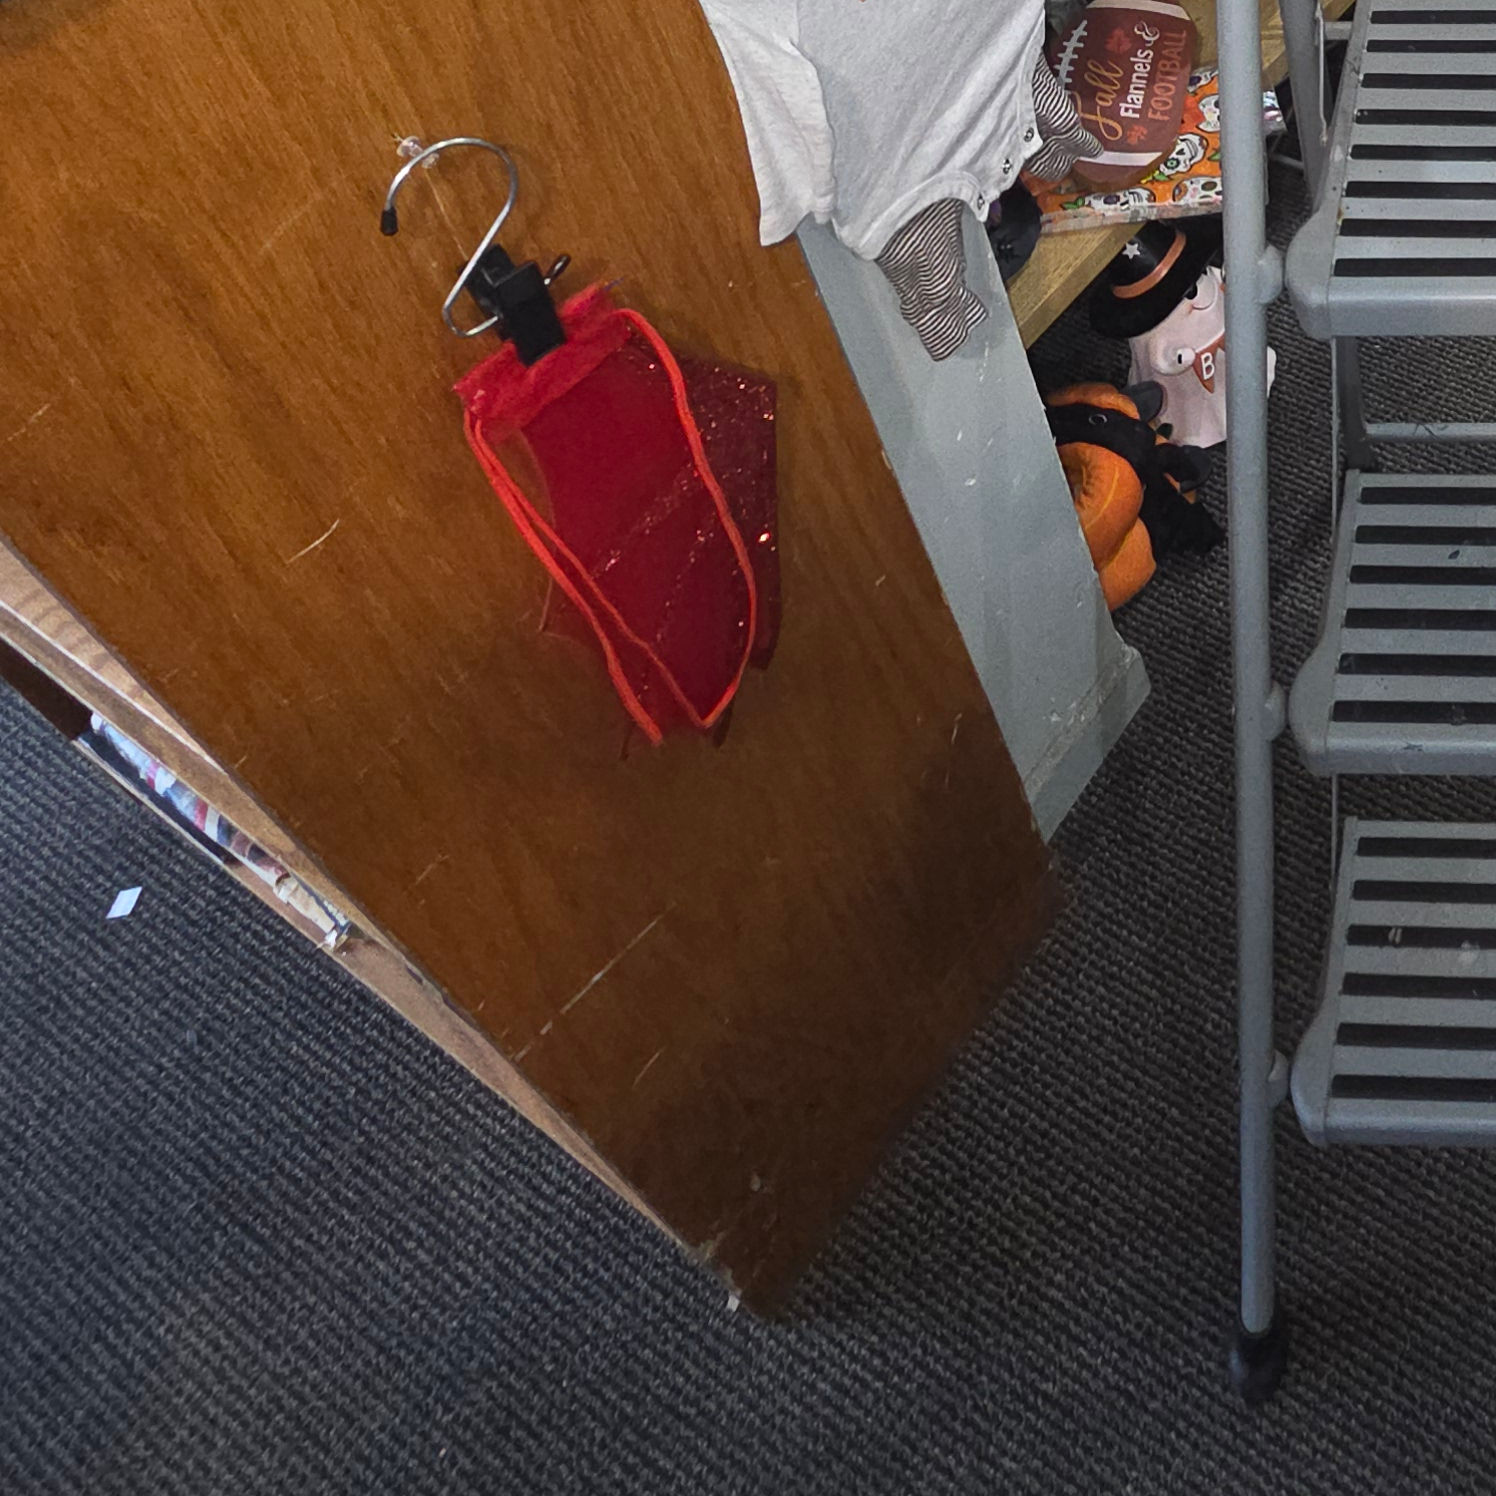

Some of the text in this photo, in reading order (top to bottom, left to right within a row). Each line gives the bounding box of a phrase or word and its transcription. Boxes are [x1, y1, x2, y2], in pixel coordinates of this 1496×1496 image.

[1070, 58, 1125, 141] Fall
[1119, 20, 1161, 119] Flannels &
[1147, 29, 1187, 121] FOOTBALL
